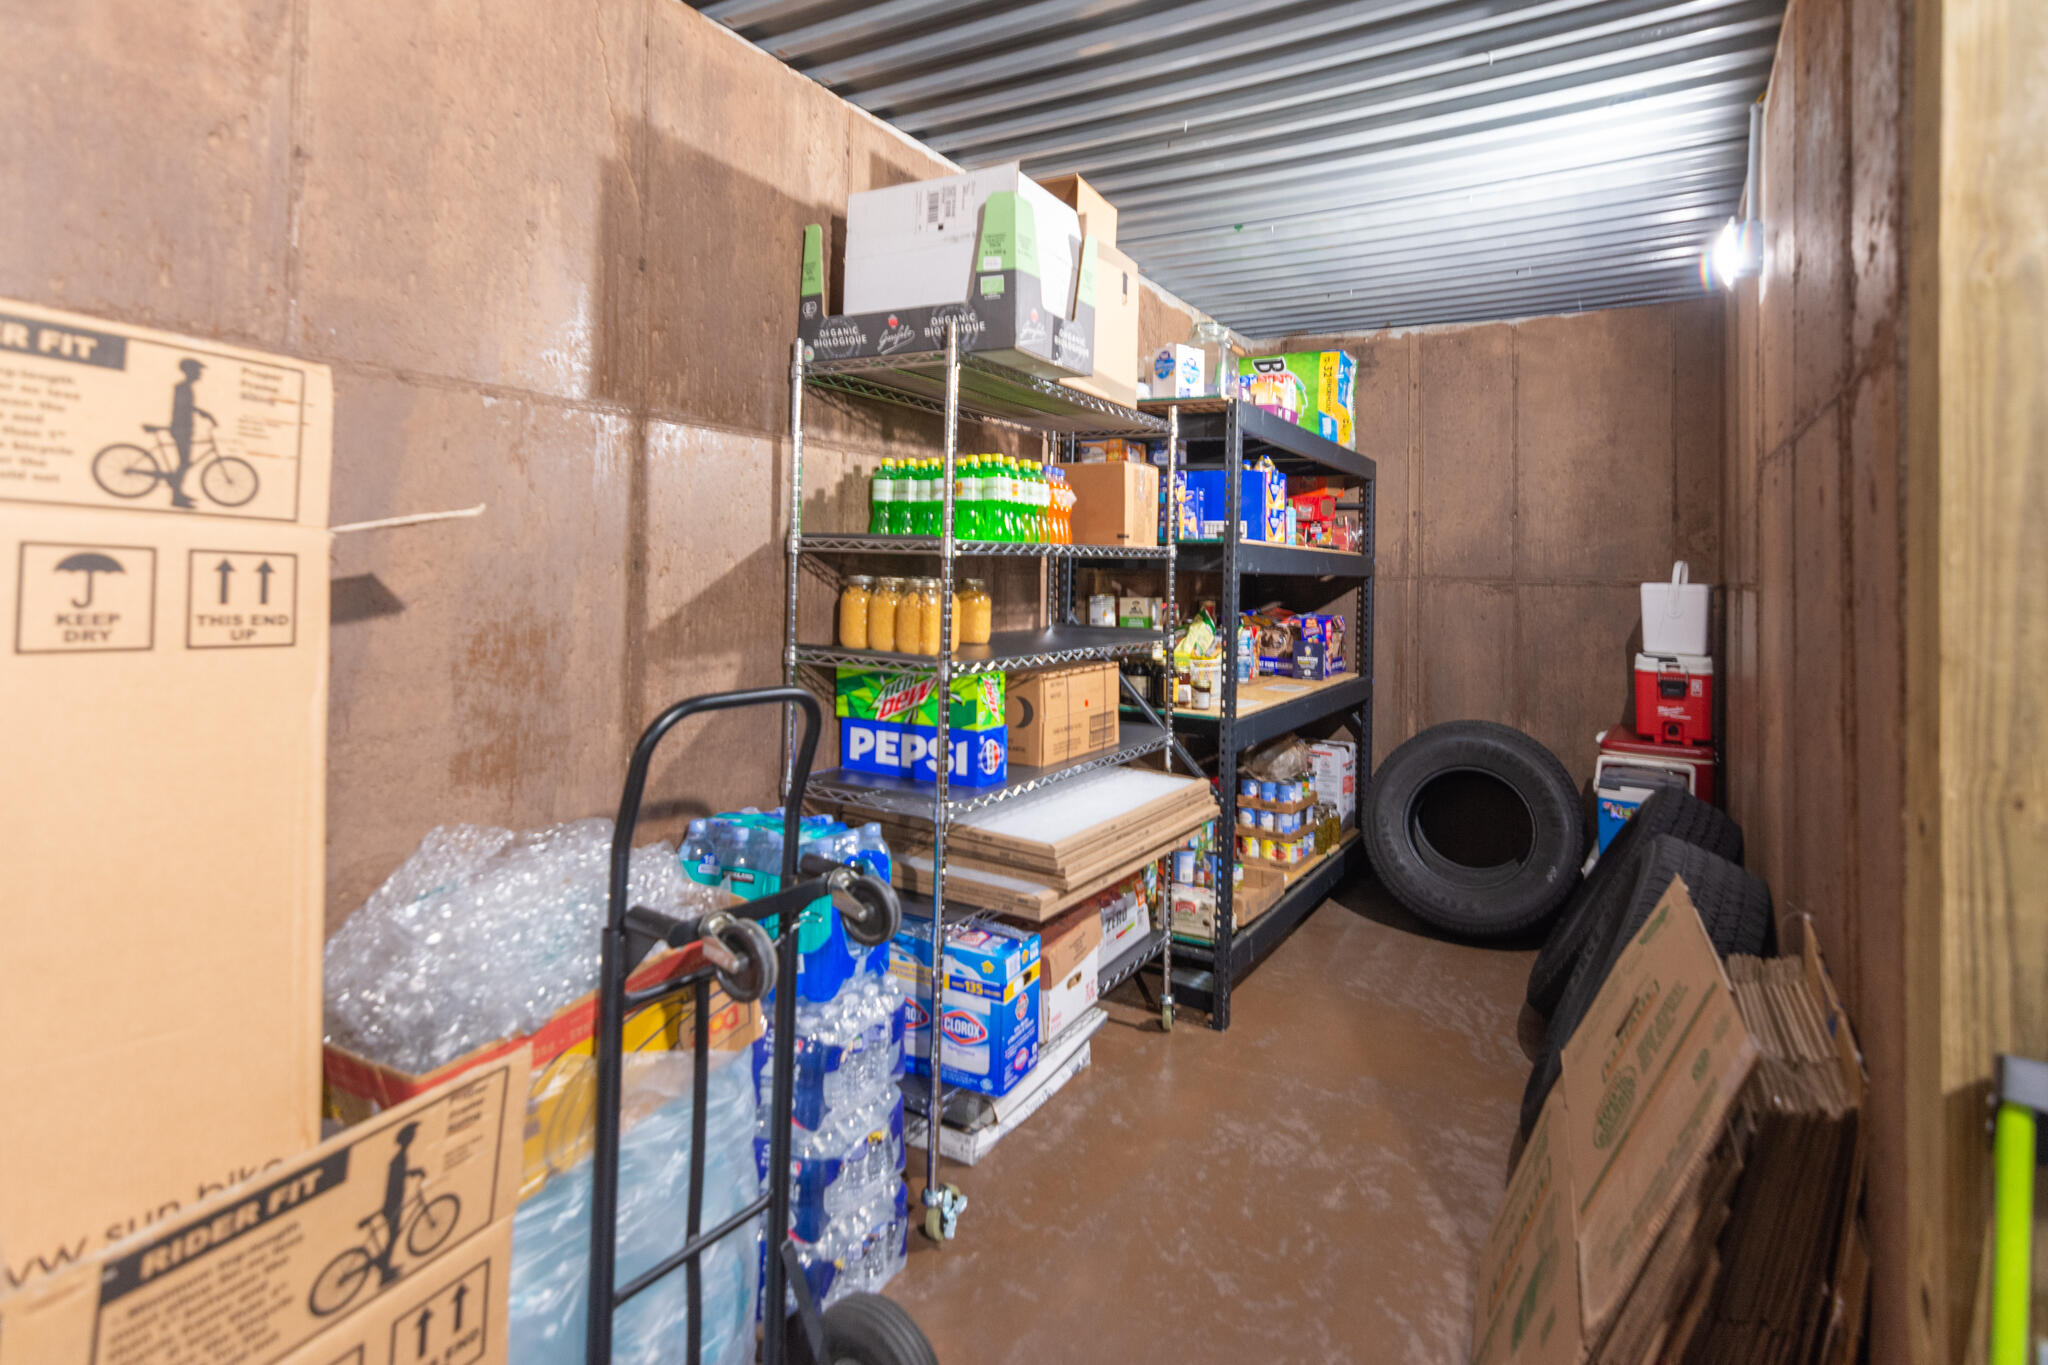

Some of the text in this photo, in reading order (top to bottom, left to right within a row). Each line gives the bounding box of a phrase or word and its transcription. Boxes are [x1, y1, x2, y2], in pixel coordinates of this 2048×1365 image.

[924, 321, 986, 337] BIOIQUE
[37, 328, 98, 361] FIT
[813, 334, 868, 348] BIOLOGIQUE
[56, 613, 121, 627] KEEP
[197, 613, 289, 626] THIS END
[63, 629, 112, 643] DRY
[230, 629, 257, 642] UP
[849, 726, 968, 777] PEPSI
[1105, 909, 1128, 933] ZERO
[964, 980, 984, 996] 135
[905, 1006, 922, 1021] ROX
[944, 1016, 980, 1040] CLOROX
[139, 1165, 324, 1281] RIDER FIT
